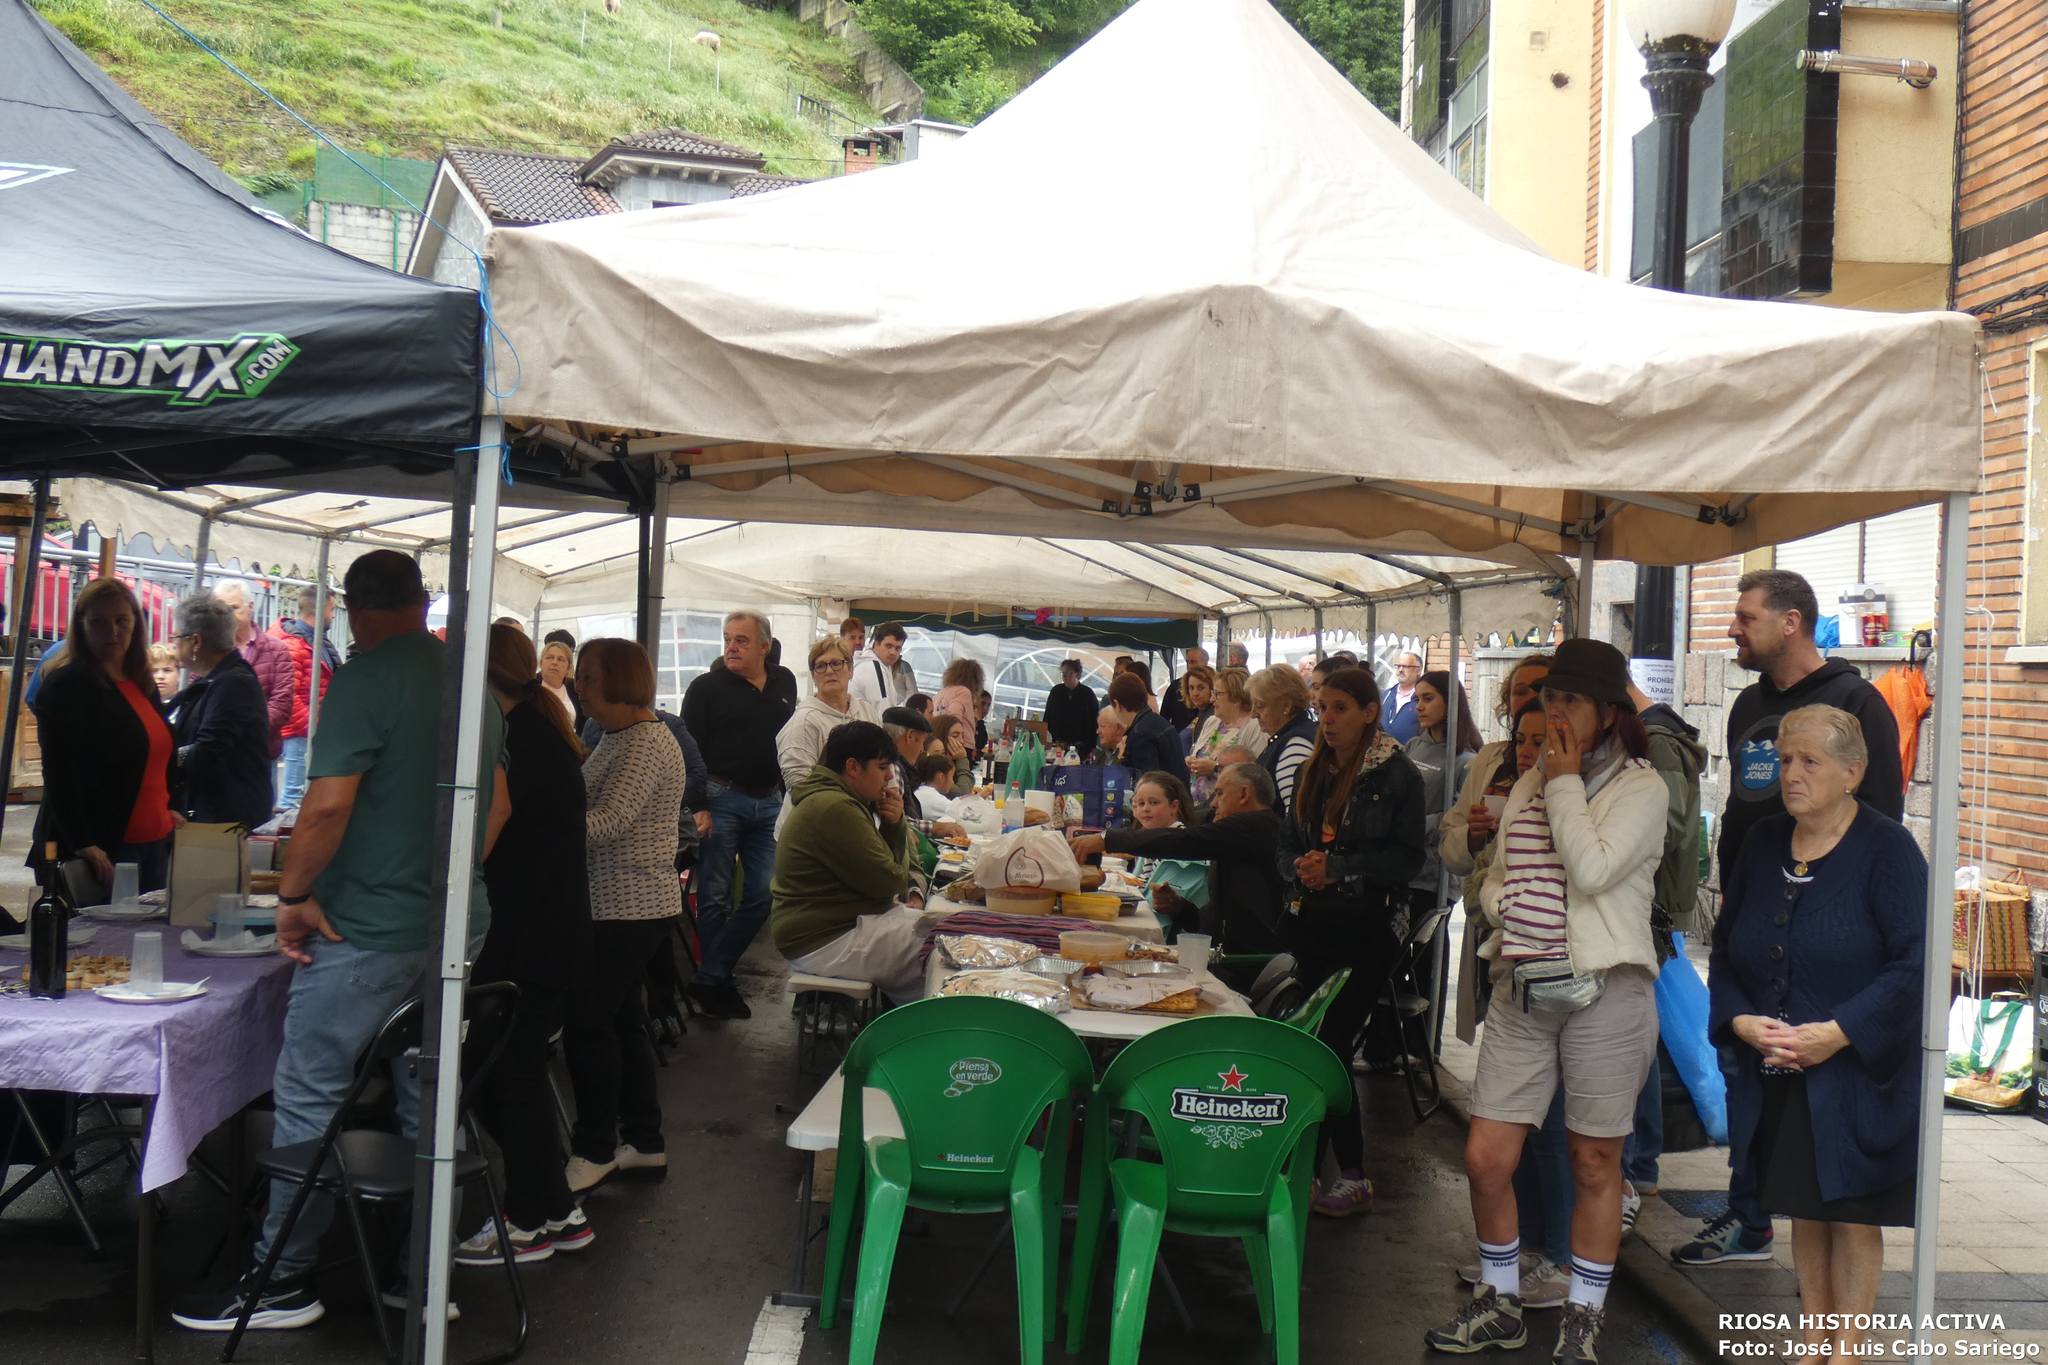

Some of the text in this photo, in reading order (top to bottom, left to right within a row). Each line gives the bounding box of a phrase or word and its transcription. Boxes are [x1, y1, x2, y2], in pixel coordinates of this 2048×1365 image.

[1744, 771, 1773, 780] JONES
[959, 1061, 990, 1072] Piensa
[956, 1073, 966, 1081] en
[946, 1153, 994, 1164] Heineken
